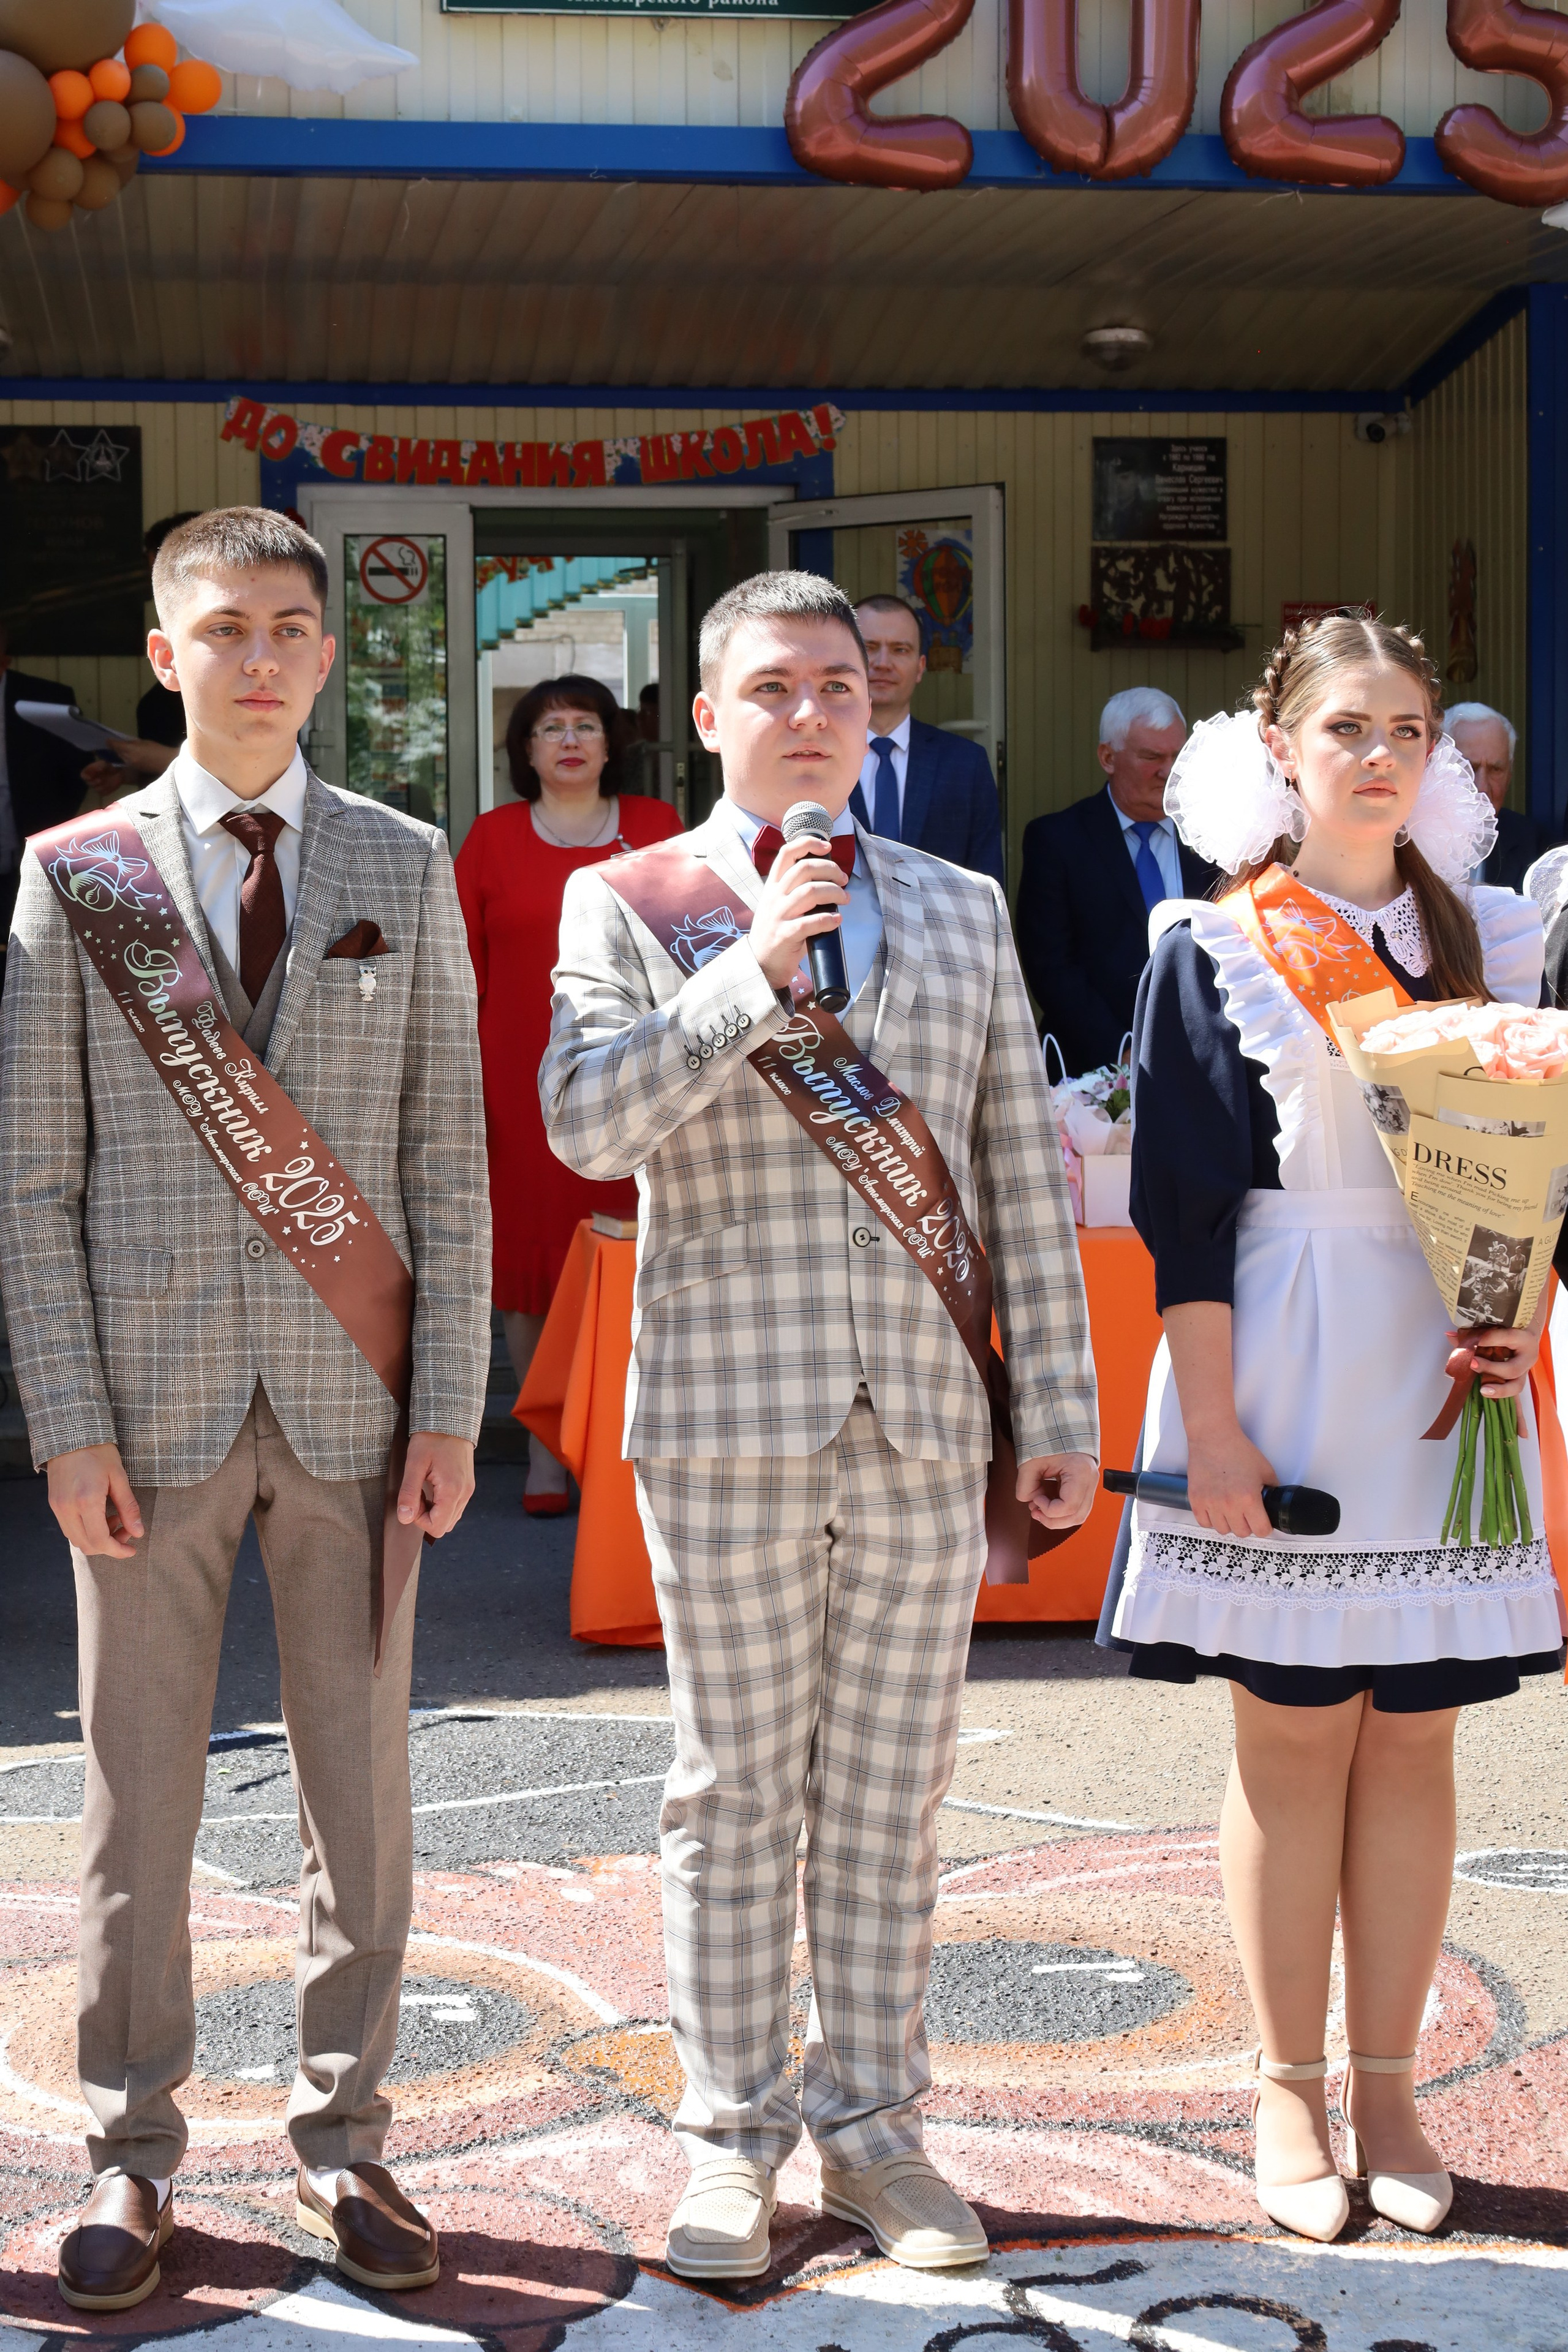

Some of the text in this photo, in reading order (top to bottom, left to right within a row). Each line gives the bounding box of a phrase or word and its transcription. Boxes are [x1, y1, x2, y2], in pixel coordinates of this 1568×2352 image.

[220, 396, 298, 461] ДО
[639, 404, 836, 483] ШКОЛА!
[118, 990, 134, 1004] 11
[127, 1008, 145, 1033] класс
[173, 1080, 204, 1117] МОУ
[124, 939, 360, 1246] Выпускник 2025
[192, 1001, 270, 1114] Фадеев Кирилл
[757, 1056, 777, 1069] 11
[769, 1072, 792, 1095] класс
[826, 1136, 862, 1171] МОУ
[771, 1013, 974, 1283] Выпускник 2025
[834, 1057, 925, 1158] Маслов Дмитрий
[1412, 1142, 1507, 1190] DRESS
[1412, 1180, 1438, 1193] Teaching
[1457, 1198, 1482, 1212] meaning
[1424, 1179, 1439, 1188] being
[1457, 1183, 1474, 1193] Thank
[1496, 1199, 1512, 1210] being
[1522, 1203, 1538, 1212] friend
[1488, 1189, 1510, 1202] Picking
